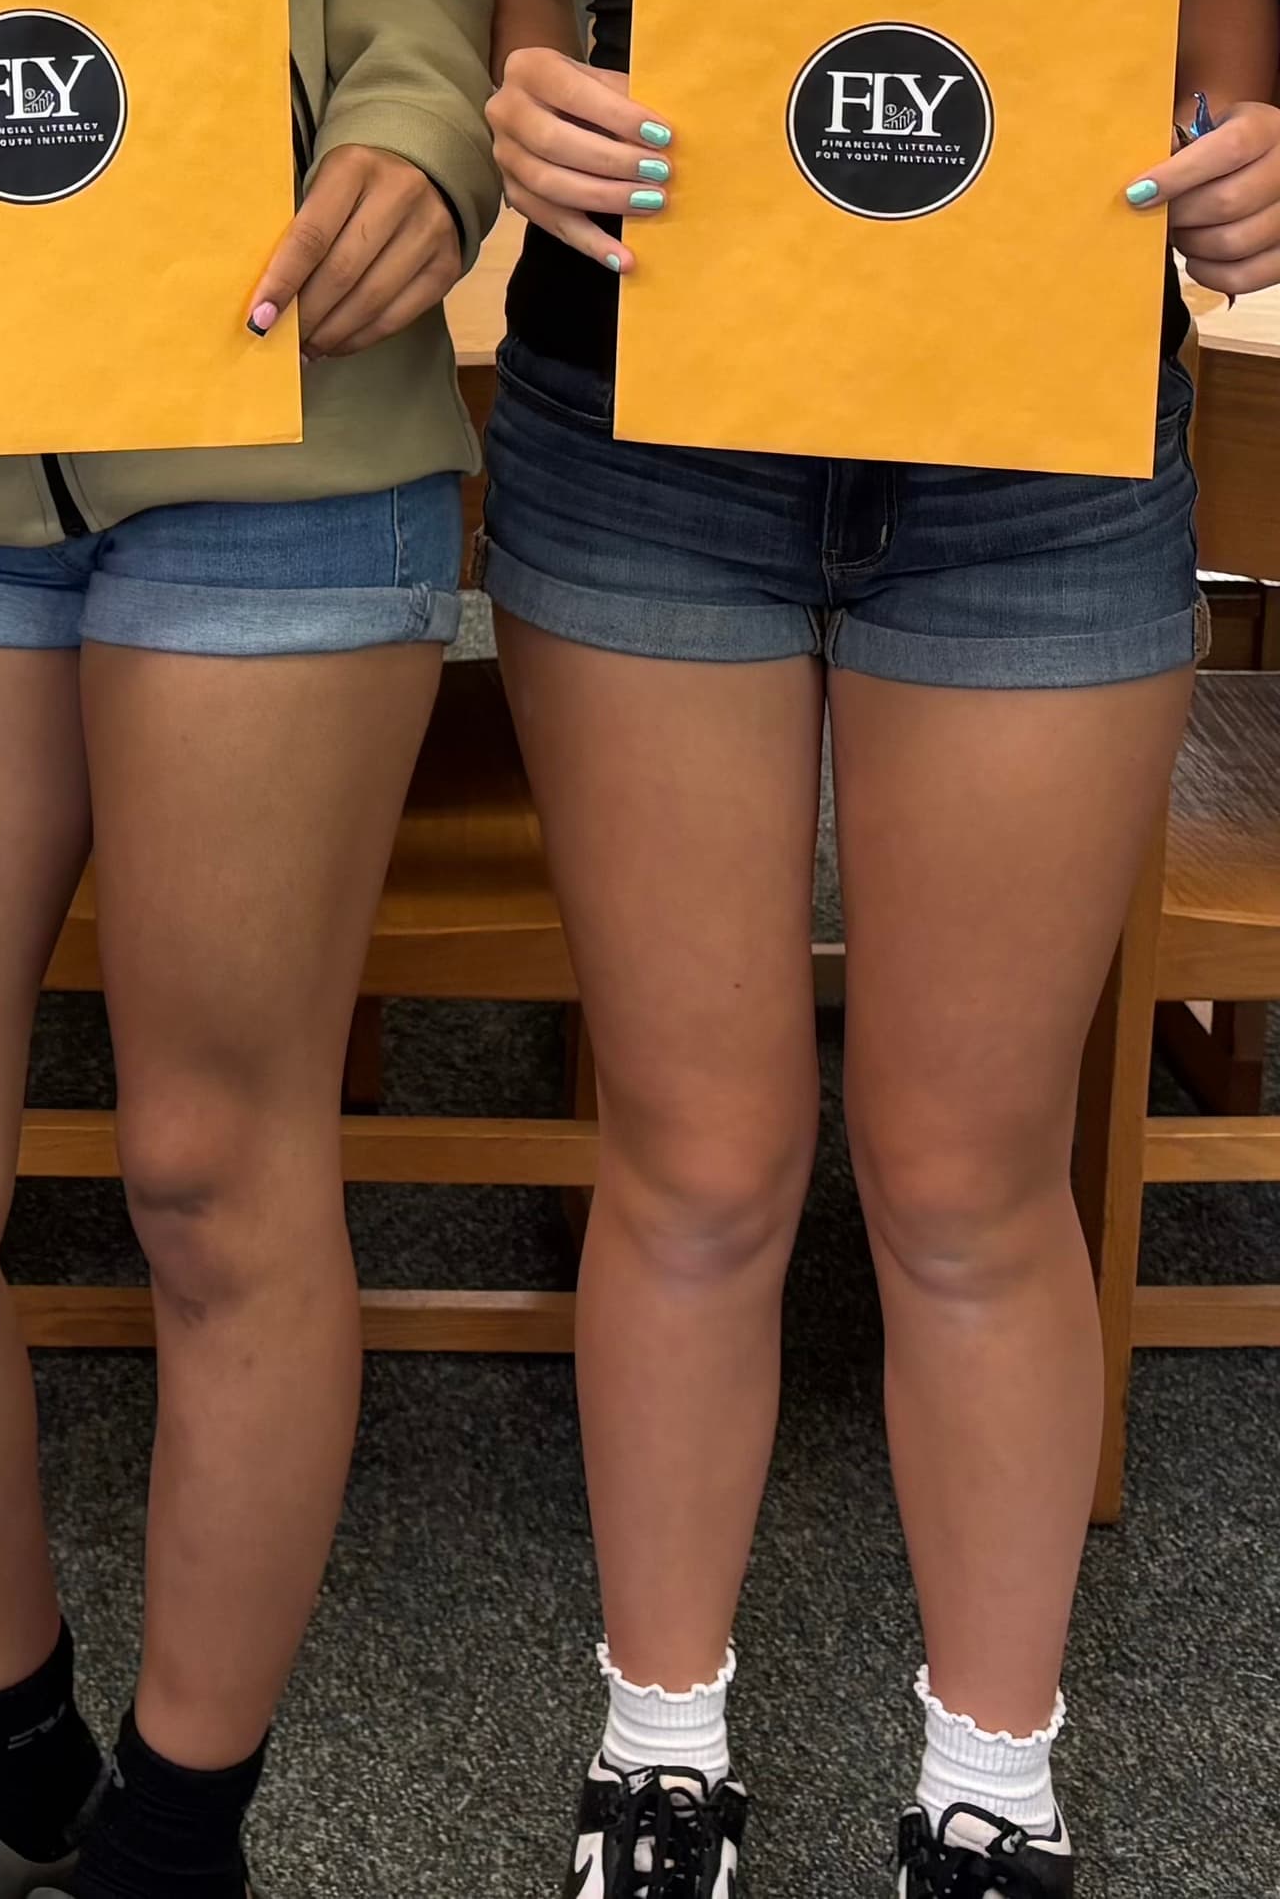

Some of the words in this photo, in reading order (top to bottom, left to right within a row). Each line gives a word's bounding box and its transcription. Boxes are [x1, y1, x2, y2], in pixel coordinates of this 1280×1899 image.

[825, 70, 965, 137] FLY
[39, 122, 99, 133] LITERACY
[37, 134, 105, 145] INITIATIVE
[821, 139, 891, 150] FINANCIAL
[898, 141, 962, 152] LITERACY
[815, 151, 840, 159] FOR
[846, 152, 889, 162] YOUTH
[894, 154, 966, 166] INITIATIVE
